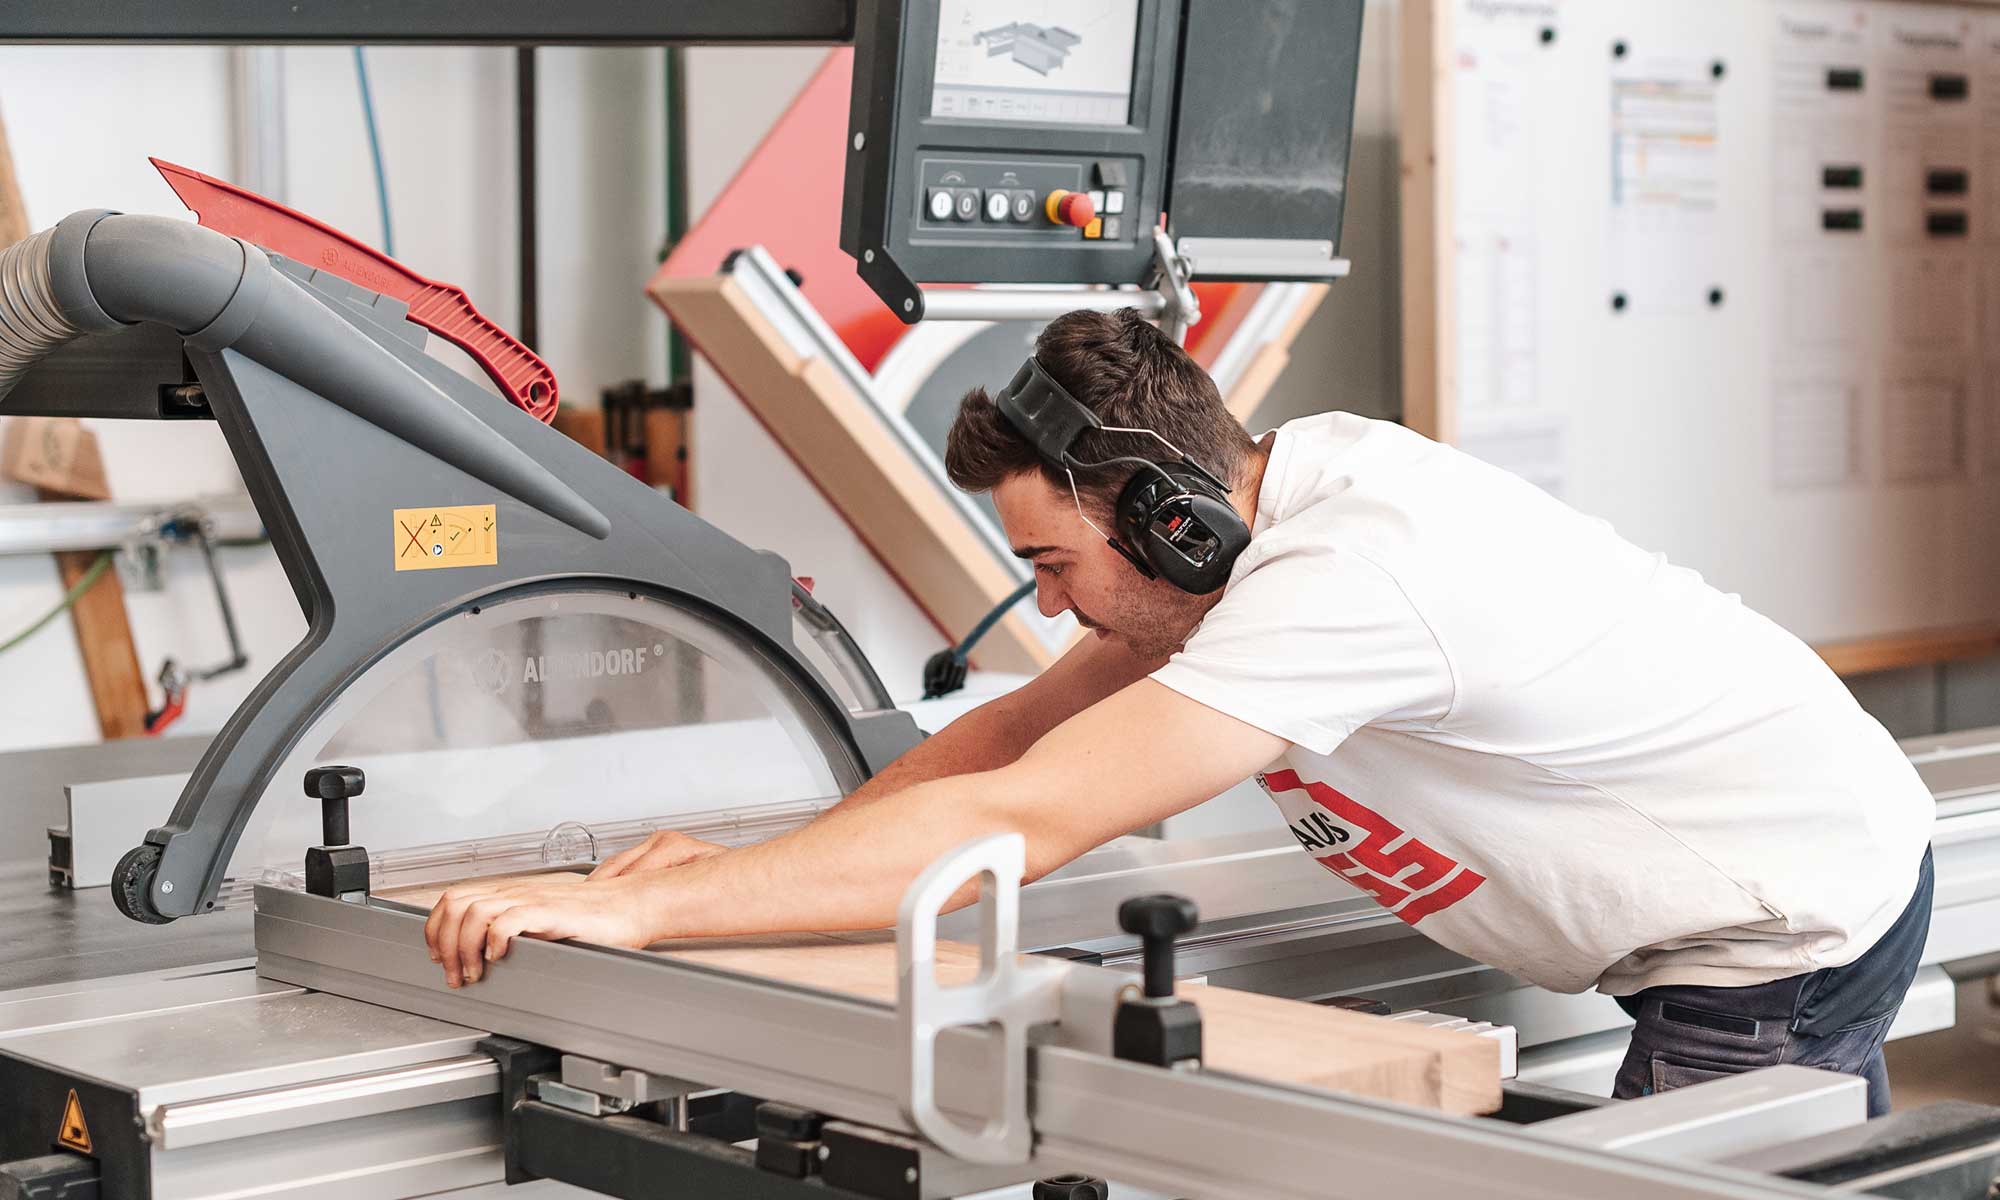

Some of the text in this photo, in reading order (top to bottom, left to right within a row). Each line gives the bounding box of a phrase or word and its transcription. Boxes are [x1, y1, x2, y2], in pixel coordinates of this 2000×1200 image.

[1167, 516, 1182, 532] 3M
[1170, 516, 1191, 541] PELTOR
[523, 647, 647, 683] ALNDORF
